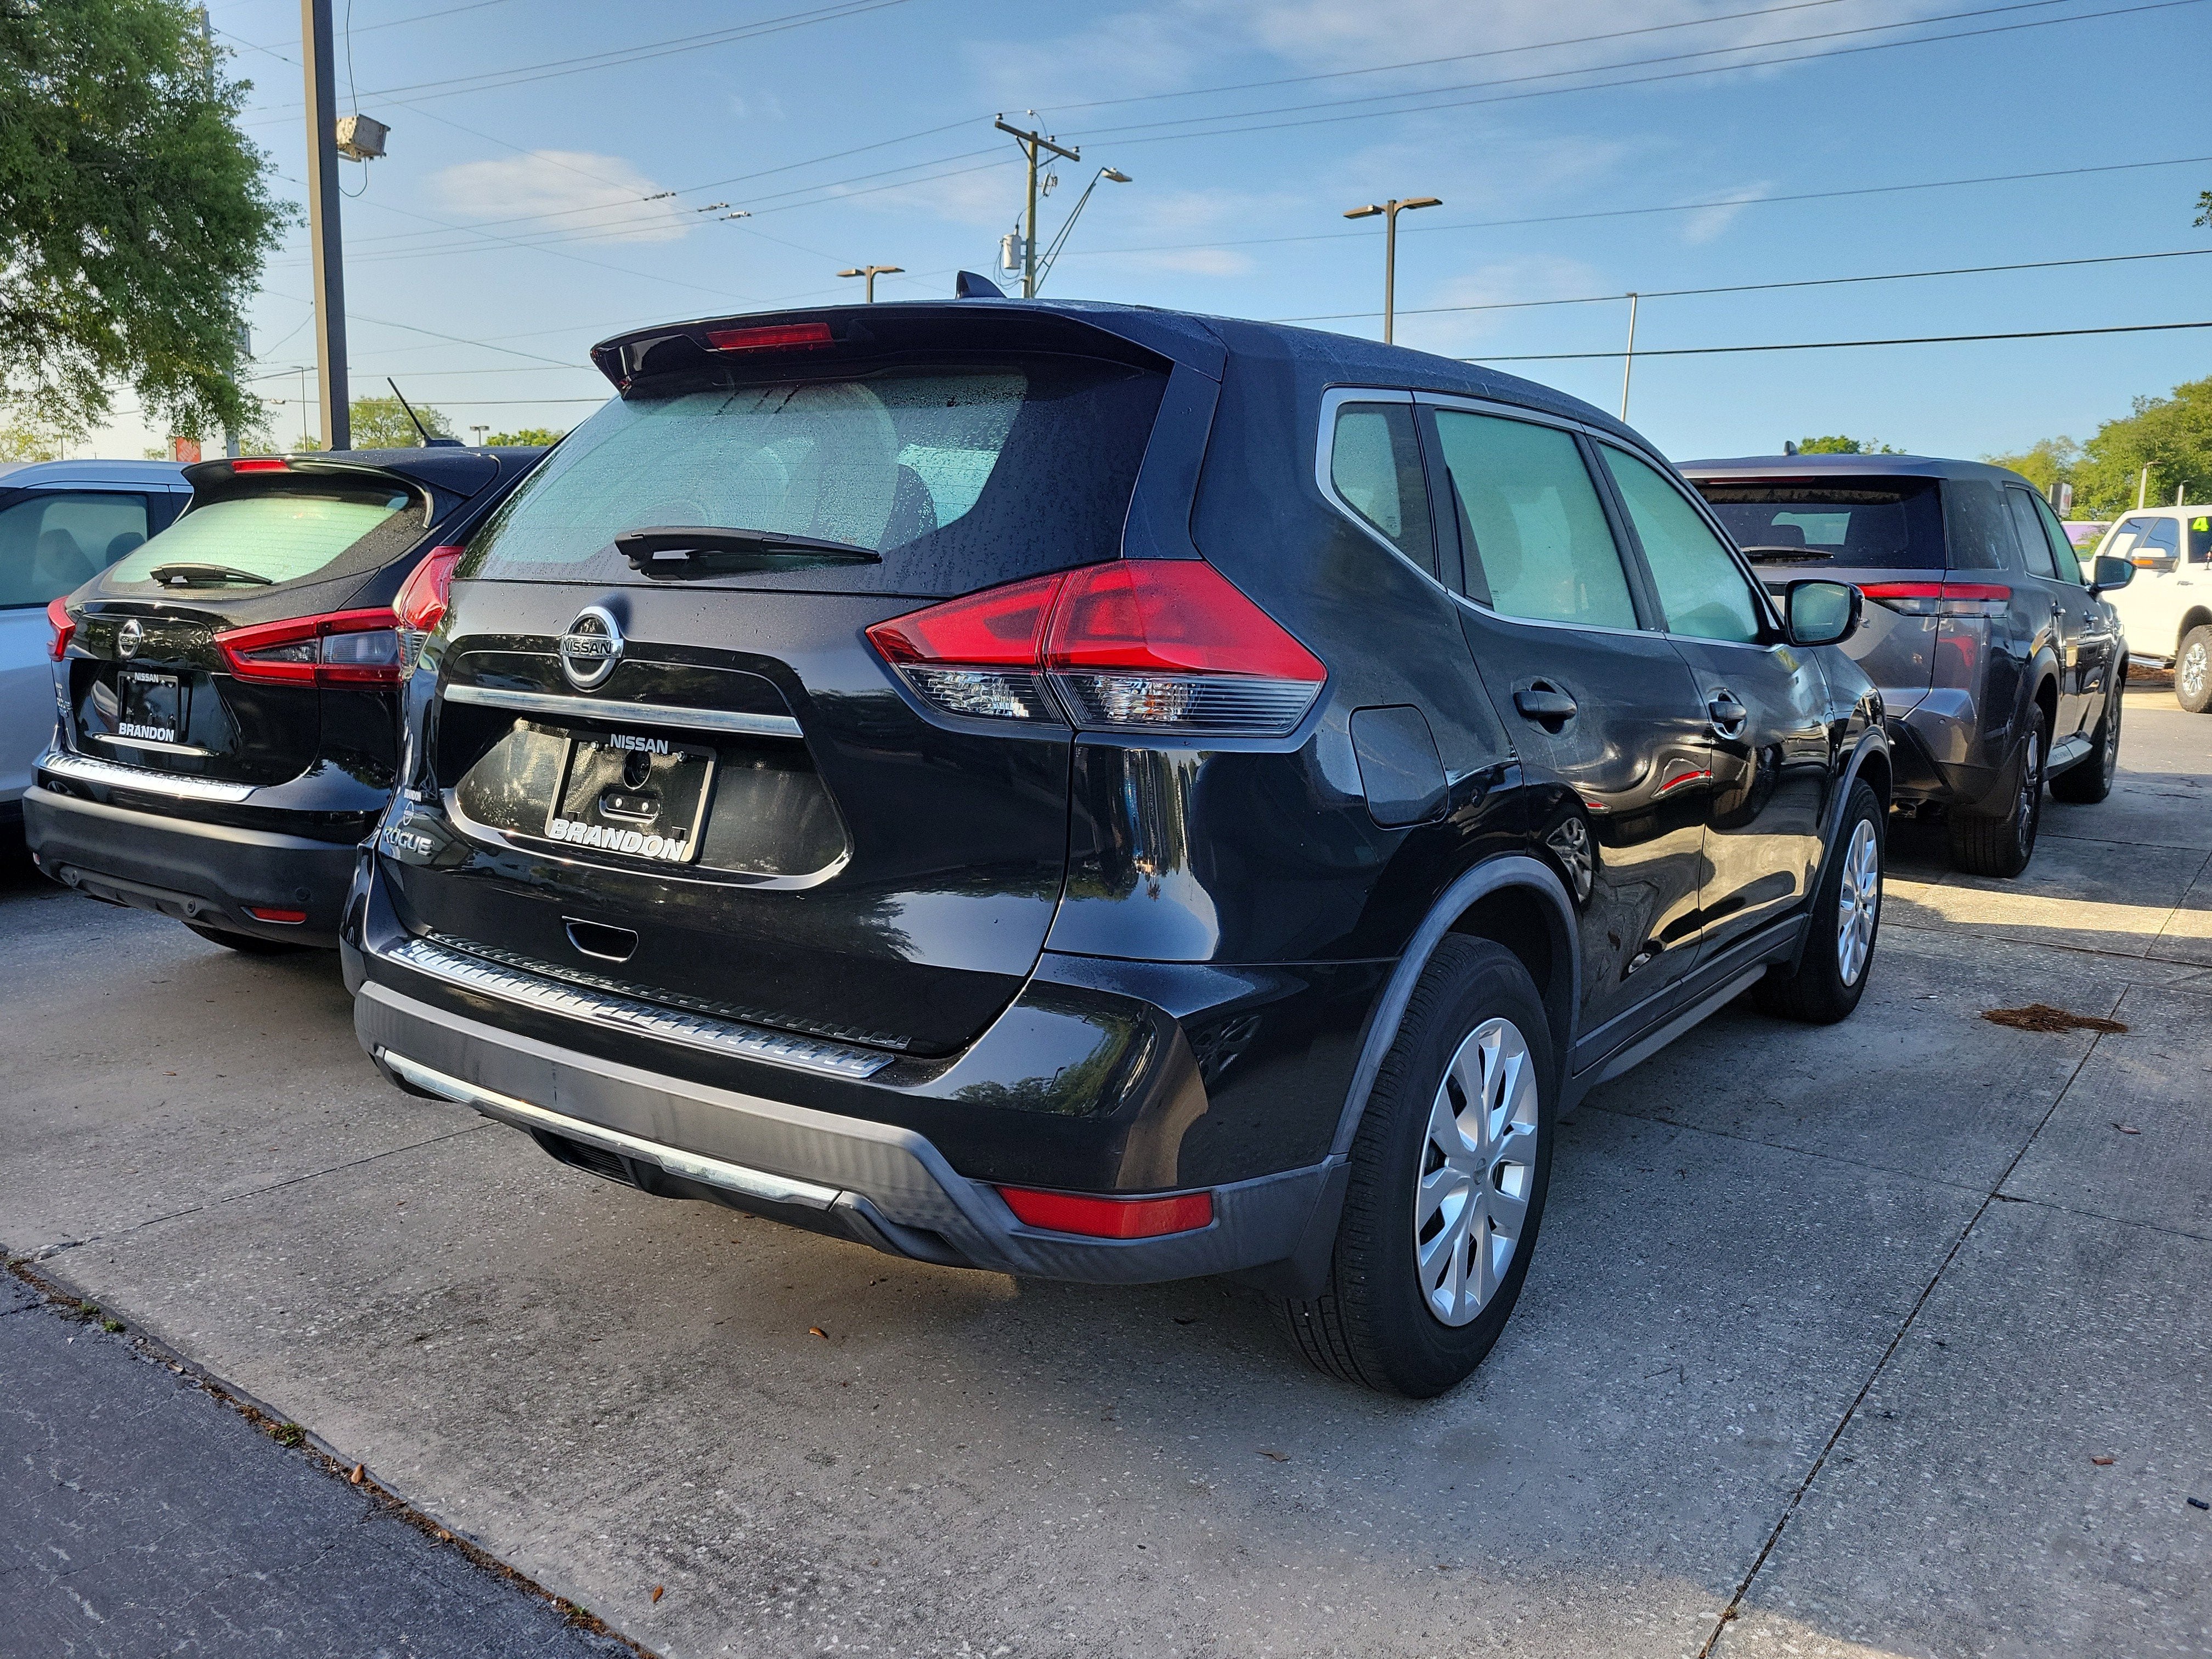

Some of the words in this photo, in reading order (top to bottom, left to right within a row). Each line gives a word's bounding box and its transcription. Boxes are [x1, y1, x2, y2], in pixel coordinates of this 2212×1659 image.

[2193, 517, 2209, 532] 4
[563, 640, 612, 654] NISSAN
[135, 672, 159, 683] NISSAN
[119, 723, 174, 742] BRANDON
[610, 733, 668, 754] NISSAN
[383, 826, 432, 856] ROGUE
[549, 818, 687, 861] BRANDON
